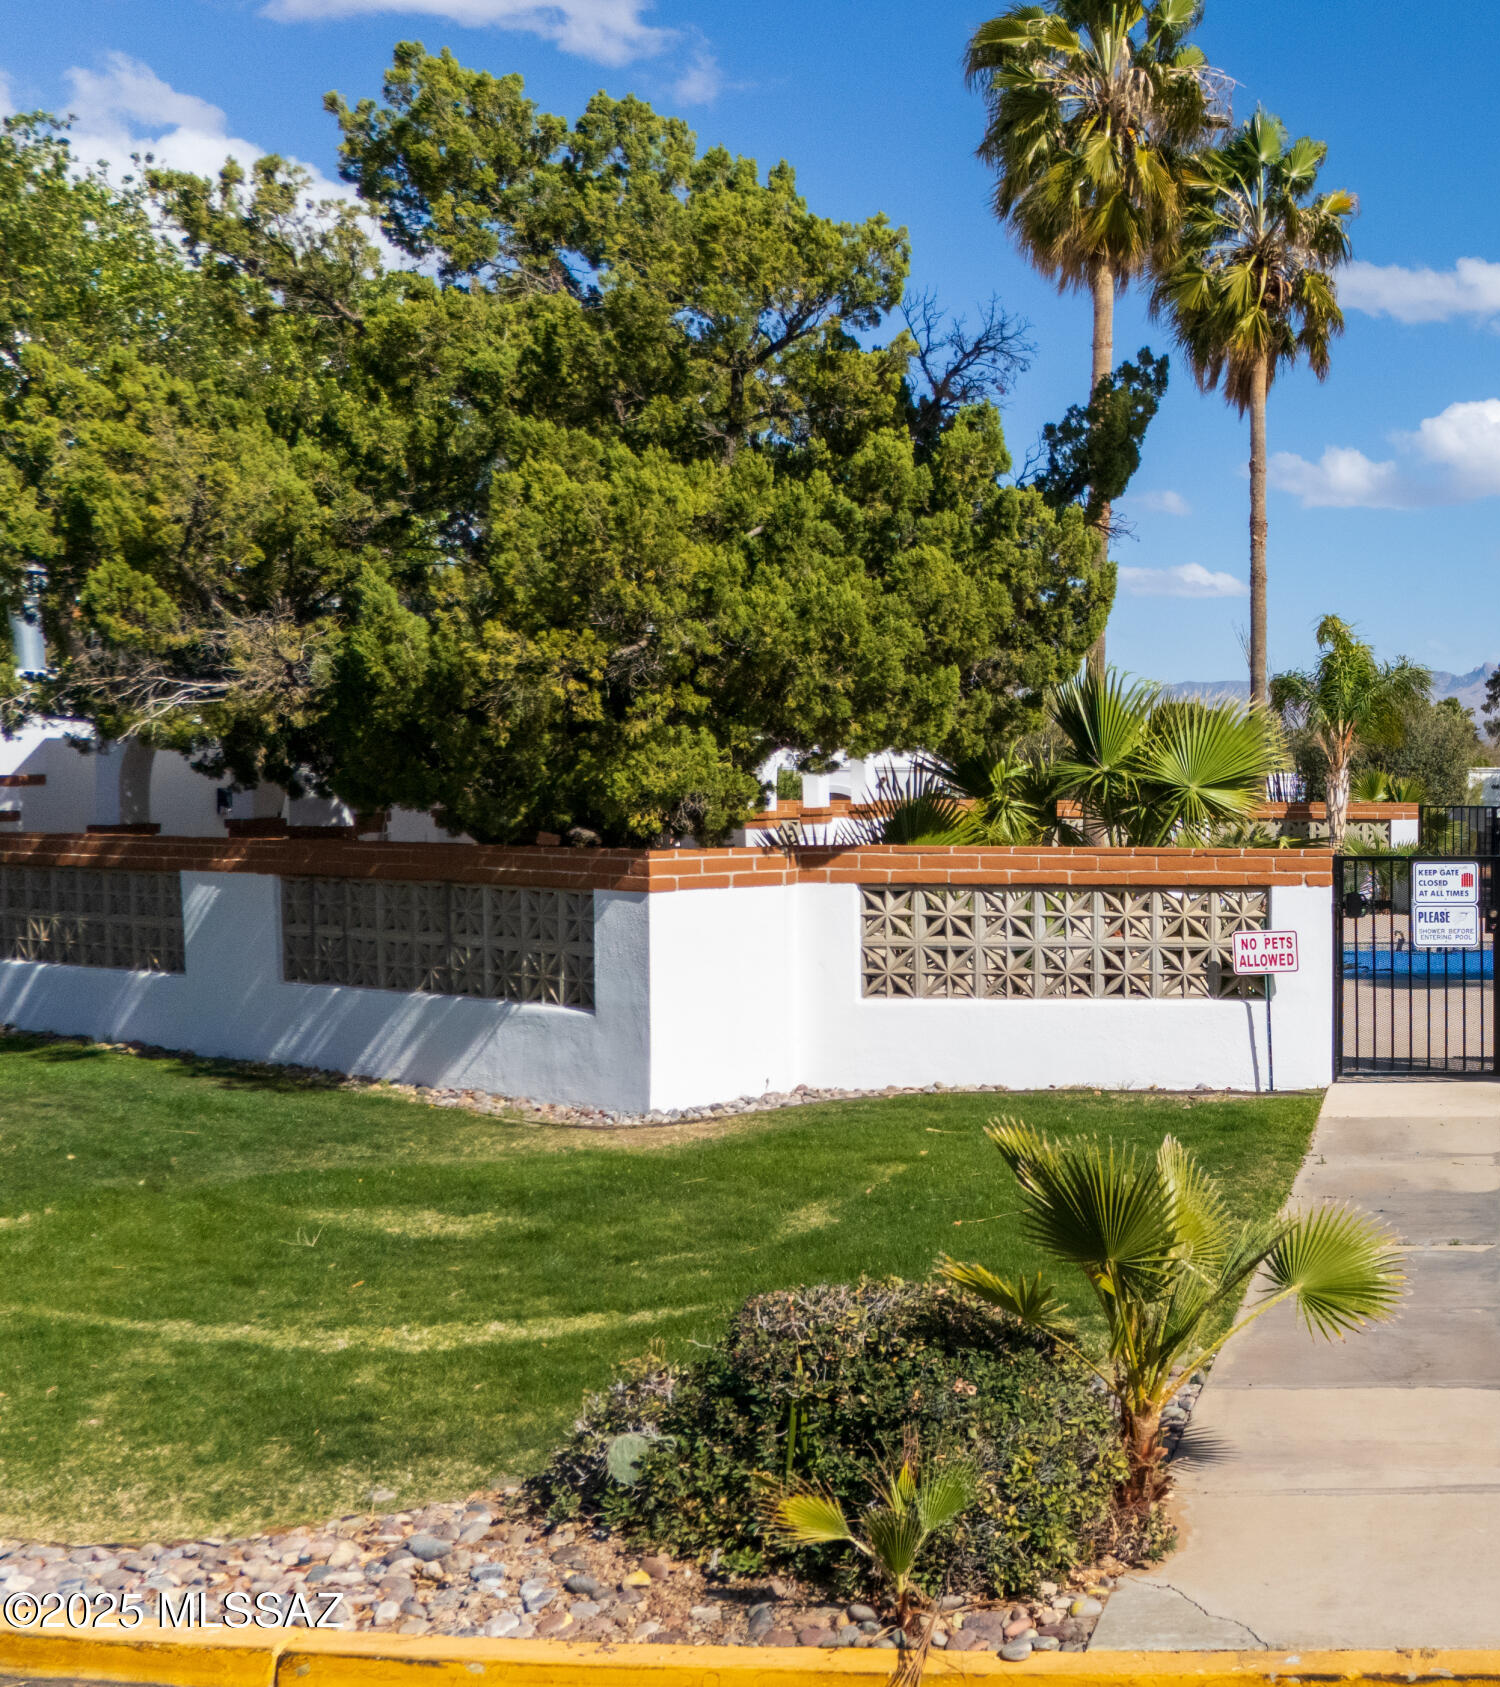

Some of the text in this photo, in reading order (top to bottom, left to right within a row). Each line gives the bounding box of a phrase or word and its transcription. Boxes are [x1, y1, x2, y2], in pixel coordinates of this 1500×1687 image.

[1418, 911, 1451, 923] PLEASE
[1241, 936, 1293, 951] NO PETS
[1239, 953, 1295, 967] ALLOWED
